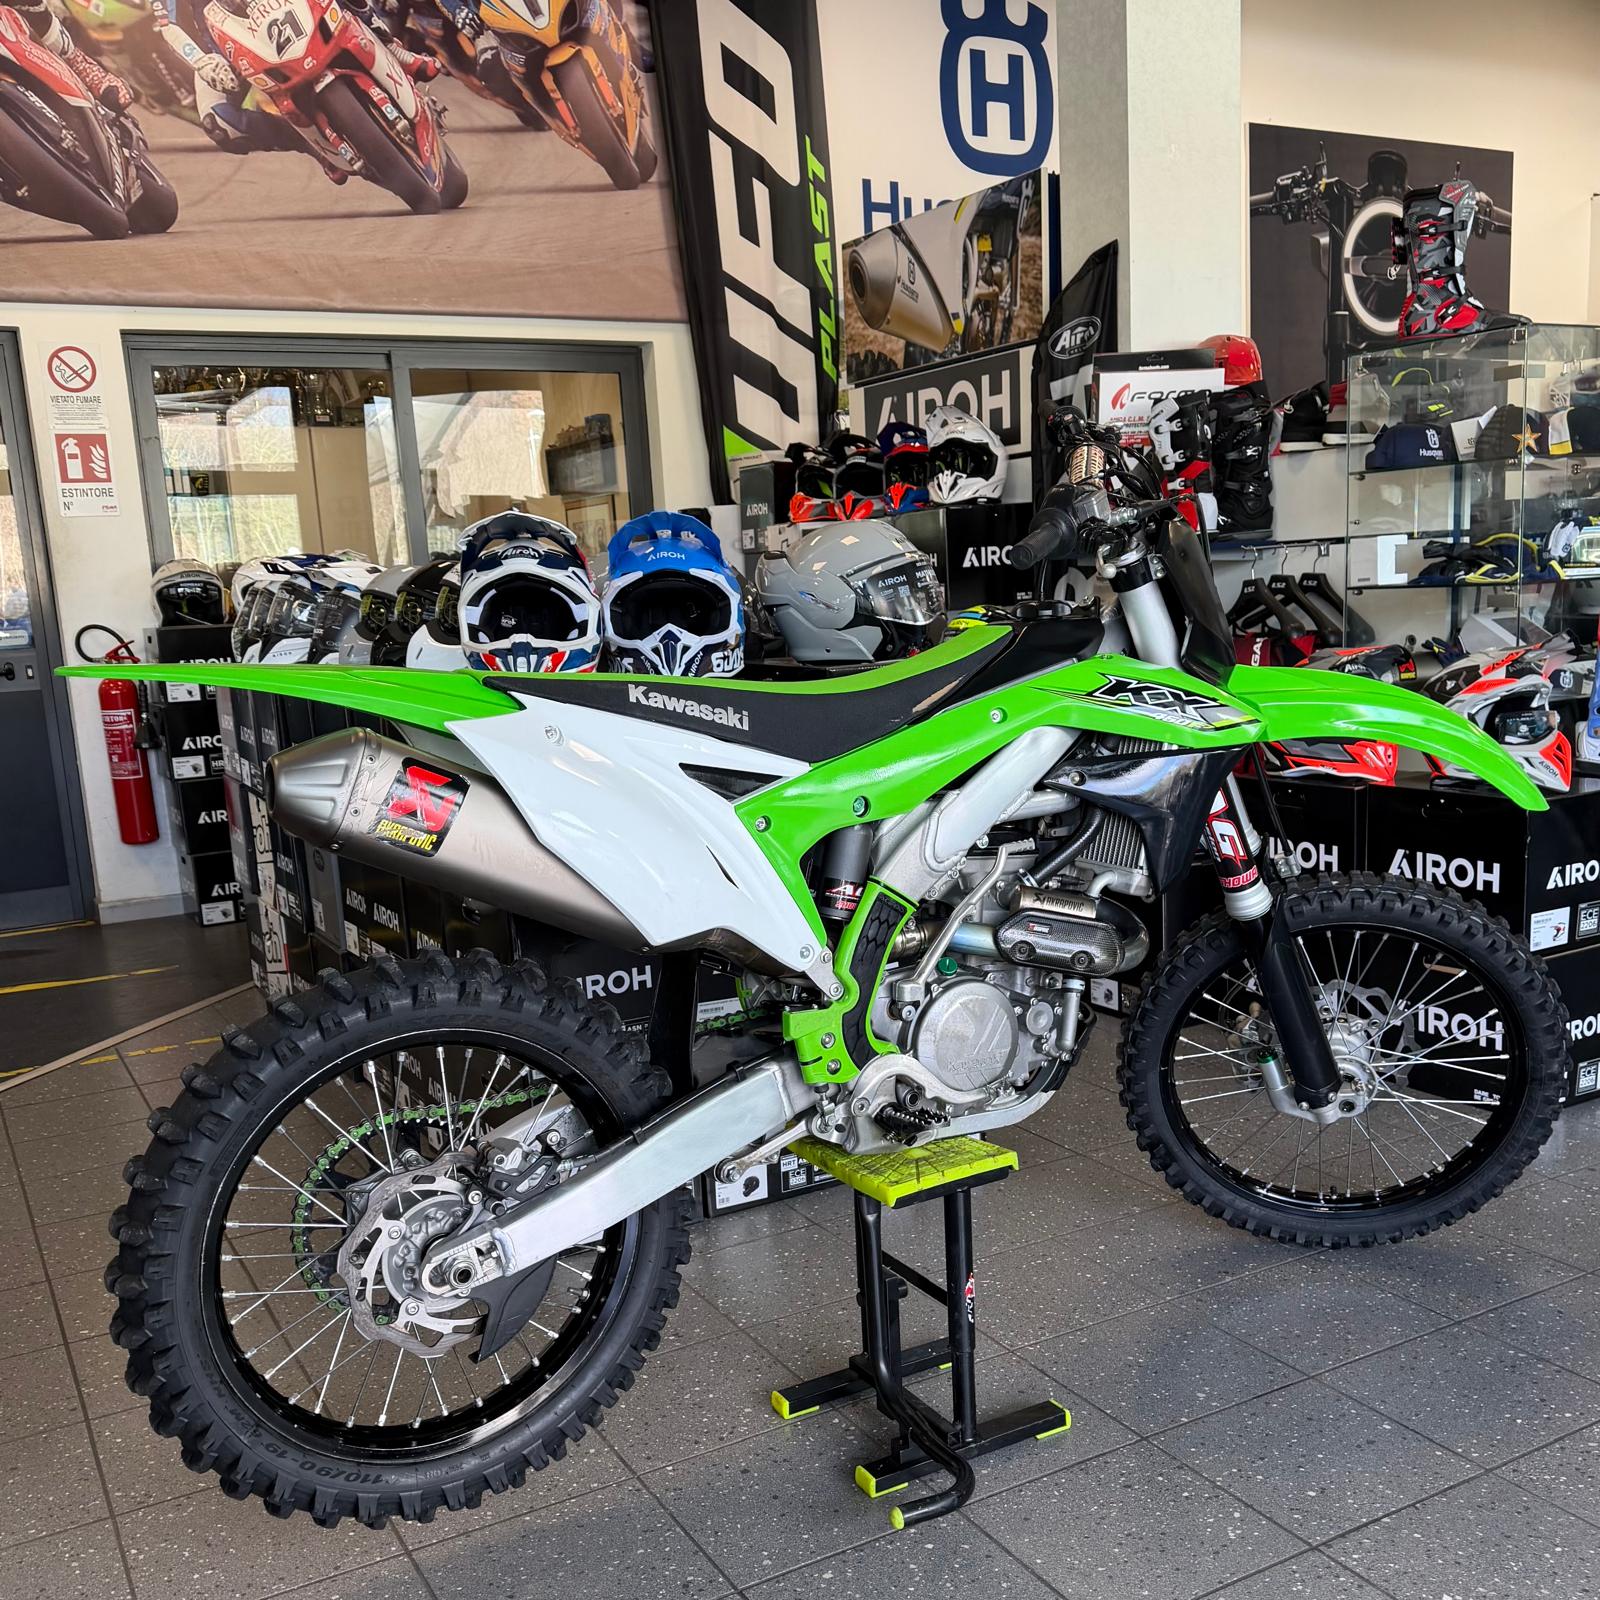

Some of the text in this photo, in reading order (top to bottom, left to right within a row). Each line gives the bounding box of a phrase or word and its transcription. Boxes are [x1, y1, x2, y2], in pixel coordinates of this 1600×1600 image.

[267, 8, 308, 59] 21
[804, 134, 837, 383] PLAST
[50, 395, 102, 404] VIETATO FUMARE
[61, 488, 114, 498] ESTINTORE
[746, 503, 769, 517] AIROH
[647, 551, 686, 562] AIROH
[877, 574, 908, 588] AIROH
[1092, 674, 1222, 723] KX
[627, 683, 750, 731] Kawasaki
[1538, 760, 1559, 778] AIROH
[1387, 848, 1500, 894] AIROH
[373, 902, 400, 933] AIROH
[1580, 908, 1599, 921] ECE
[782, 1160, 797, 1169] HRT
[789, 1167, 807, 1178] ECE
